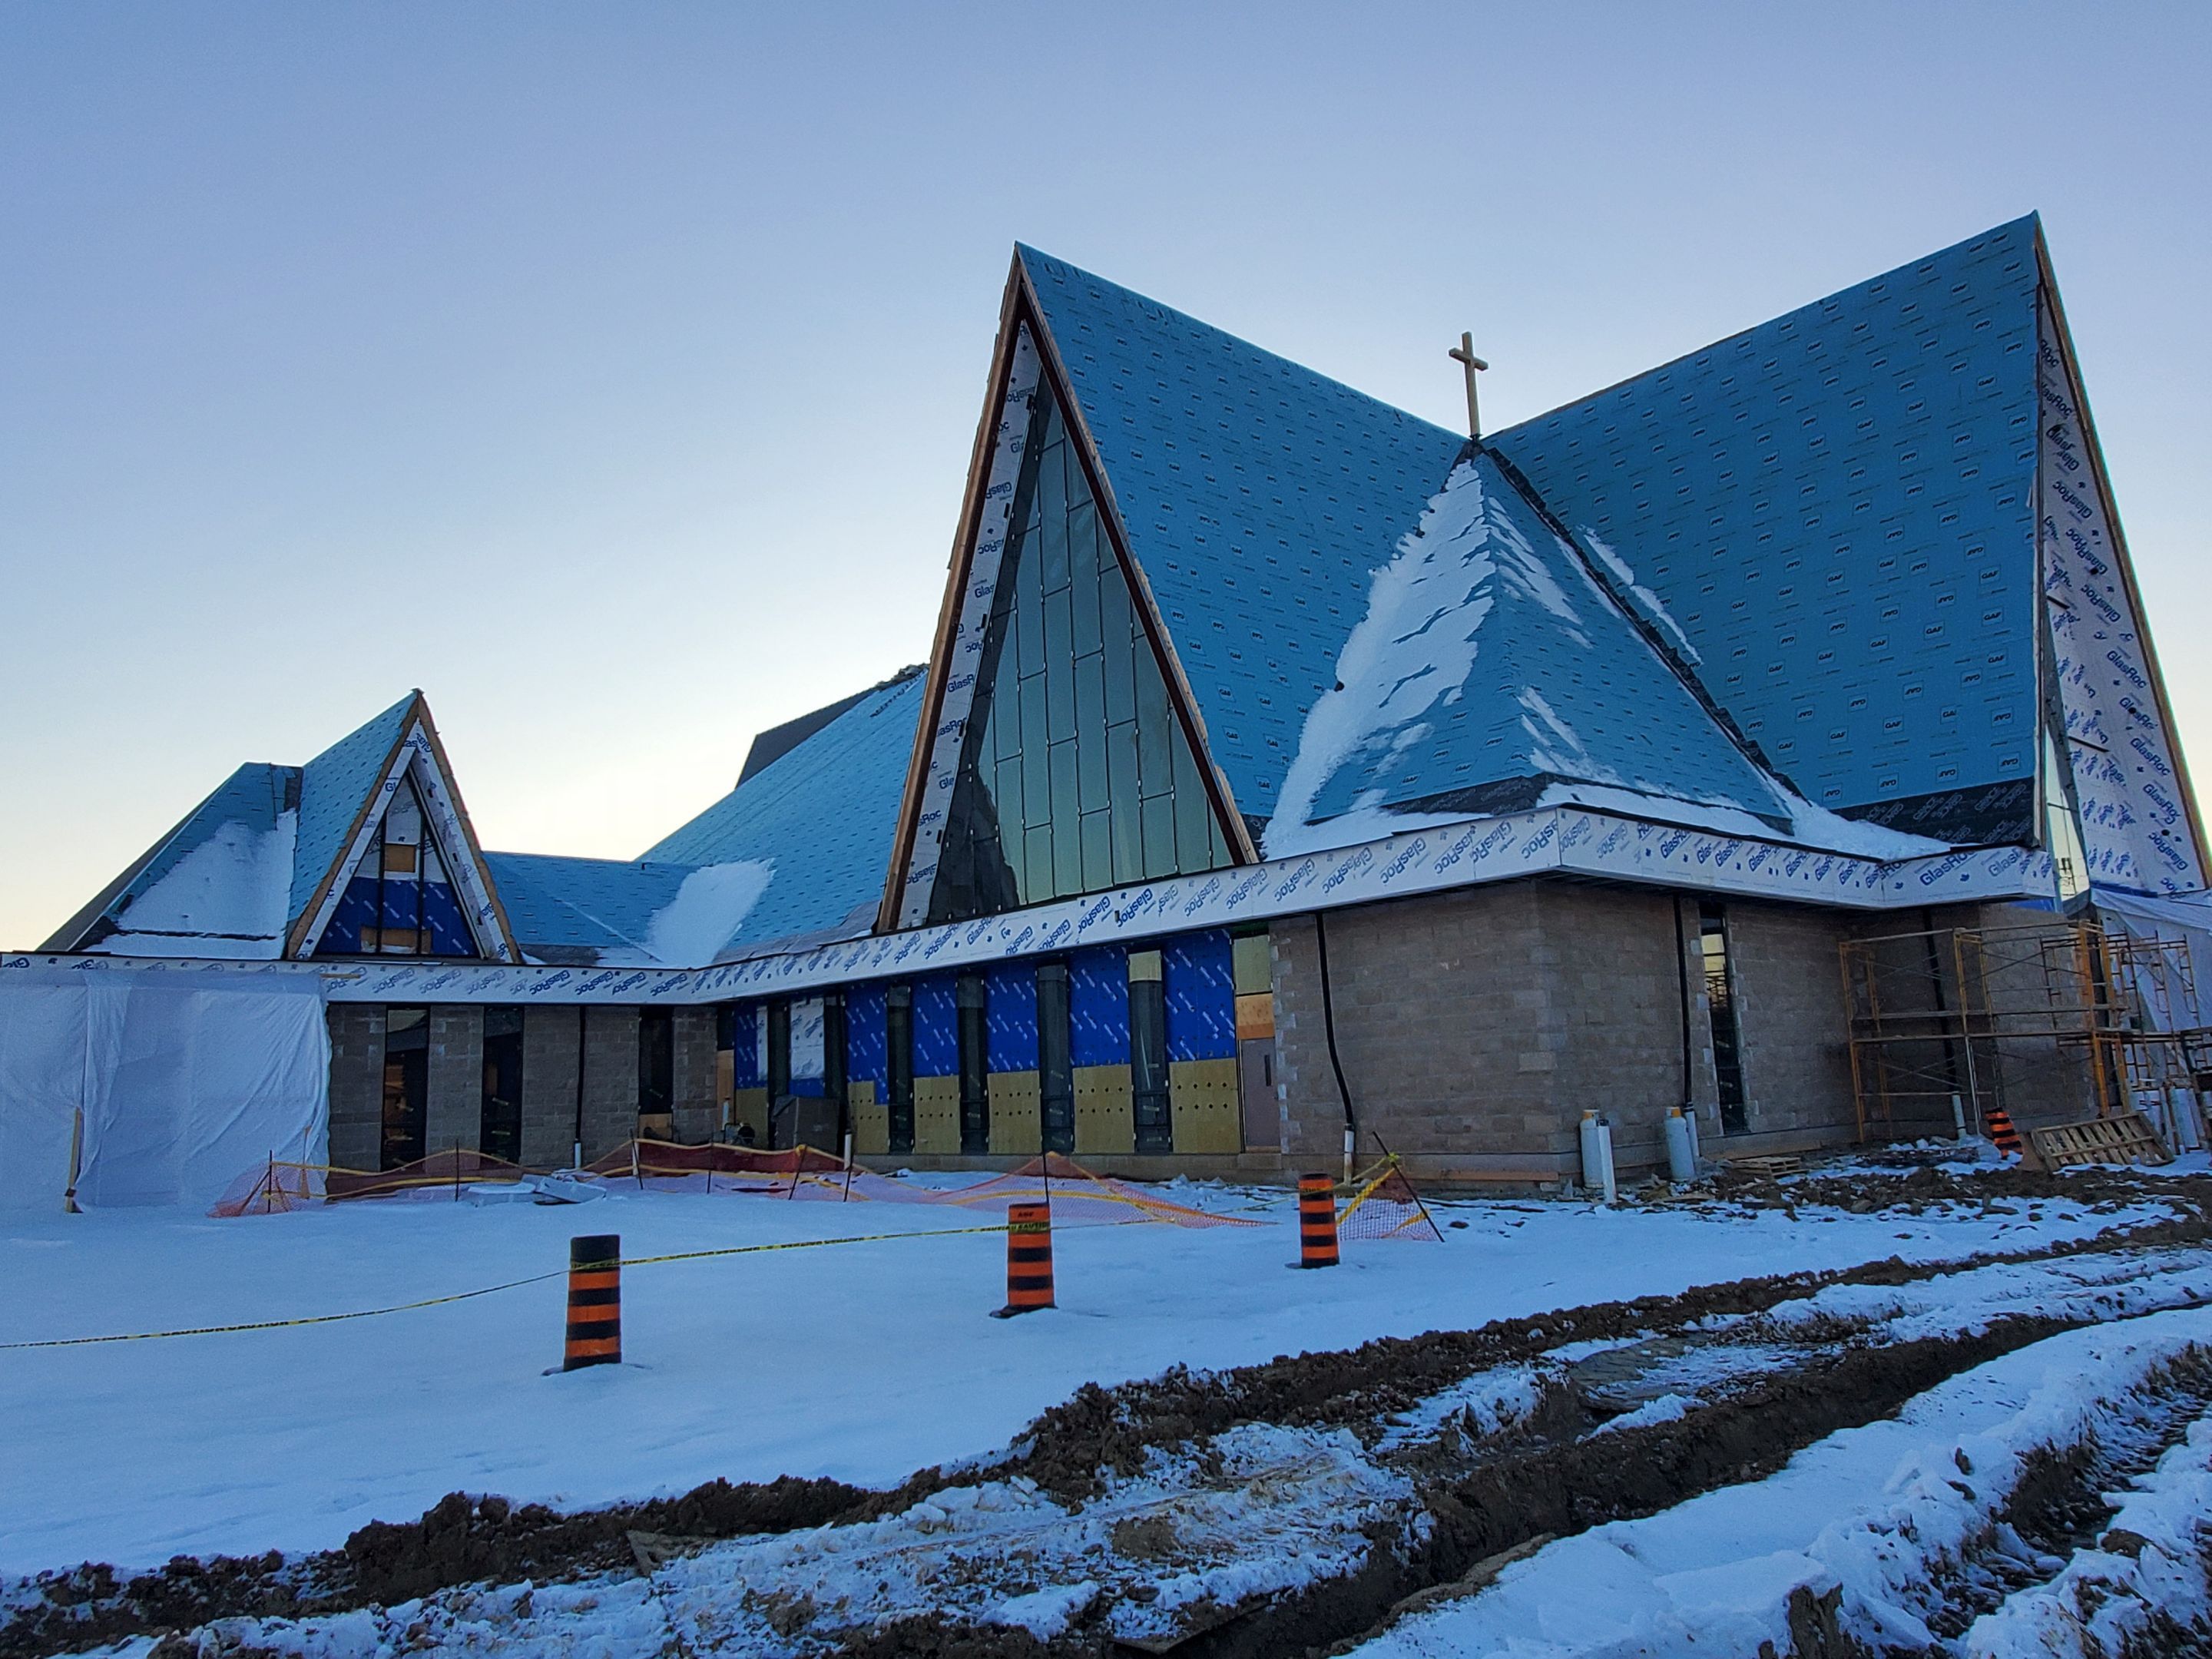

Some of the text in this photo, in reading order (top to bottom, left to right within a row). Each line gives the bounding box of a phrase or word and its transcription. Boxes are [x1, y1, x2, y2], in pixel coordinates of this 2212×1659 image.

[2052, 481, 2092, 518] GlasRoc
[2081, 584, 2121, 622] GlasRoc
[2107, 651, 2147, 688] GlasRoc
[2130, 738, 2170, 776] GlasRoc
[1381, 837, 1426, 884] GlasRoc
[2148, 833, 2187, 870] GlasRoc
[1184, 876, 1220, 917] GlasRoc
[1275, 857, 1316, 902] GlasRoc
[529, 969, 571, 995] GlasRoc
[575, 971, 614, 995] GlasRoc
